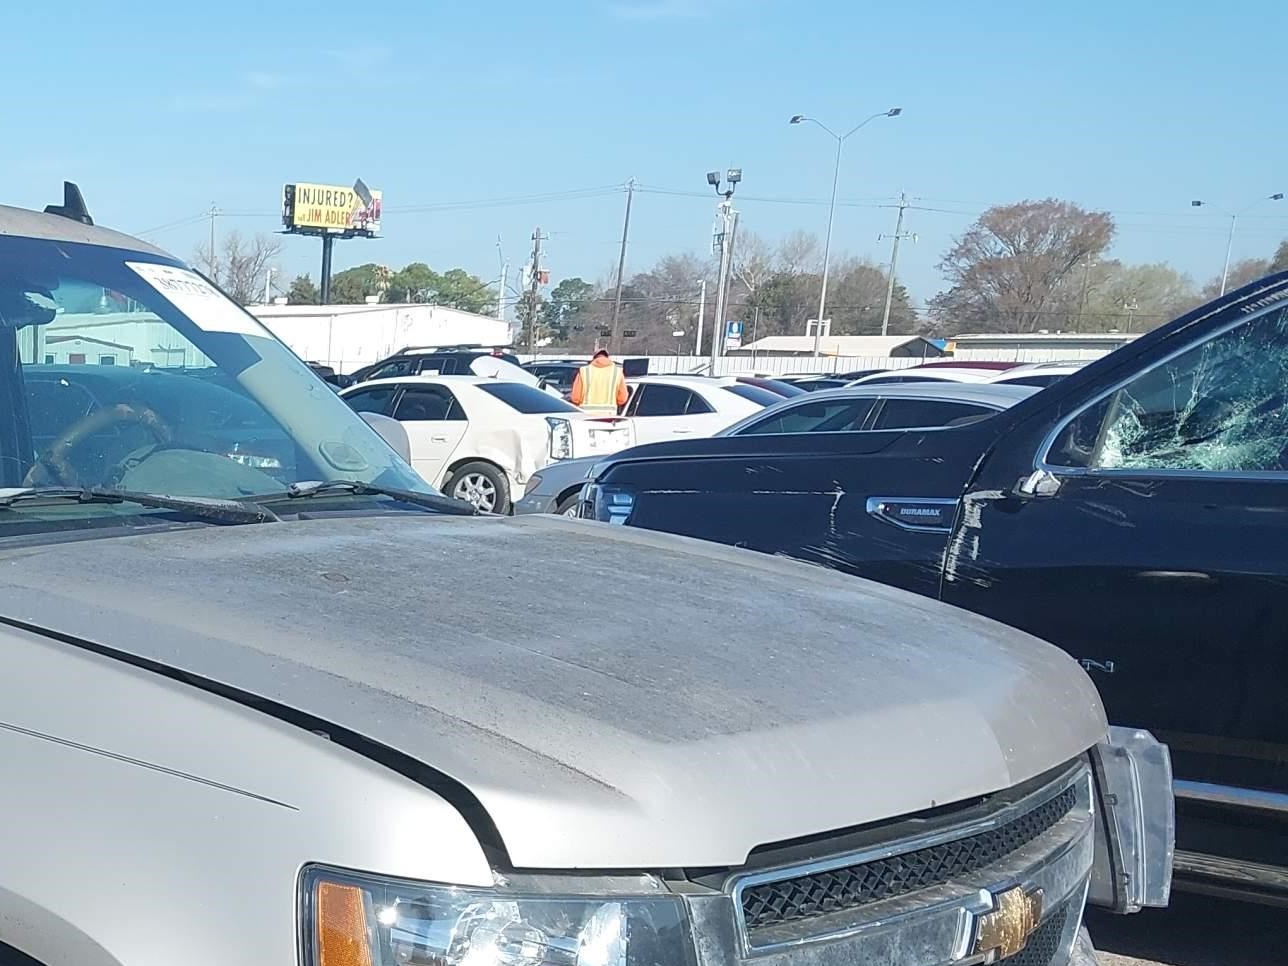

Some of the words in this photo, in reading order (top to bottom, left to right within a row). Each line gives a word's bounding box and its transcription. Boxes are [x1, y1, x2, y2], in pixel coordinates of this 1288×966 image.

[298, 187, 354, 209] INJURED?
[307, 208, 322, 224] JIM
[325, 211, 352, 226] ADLER
[900, 508, 941, 516] DURAMAX
